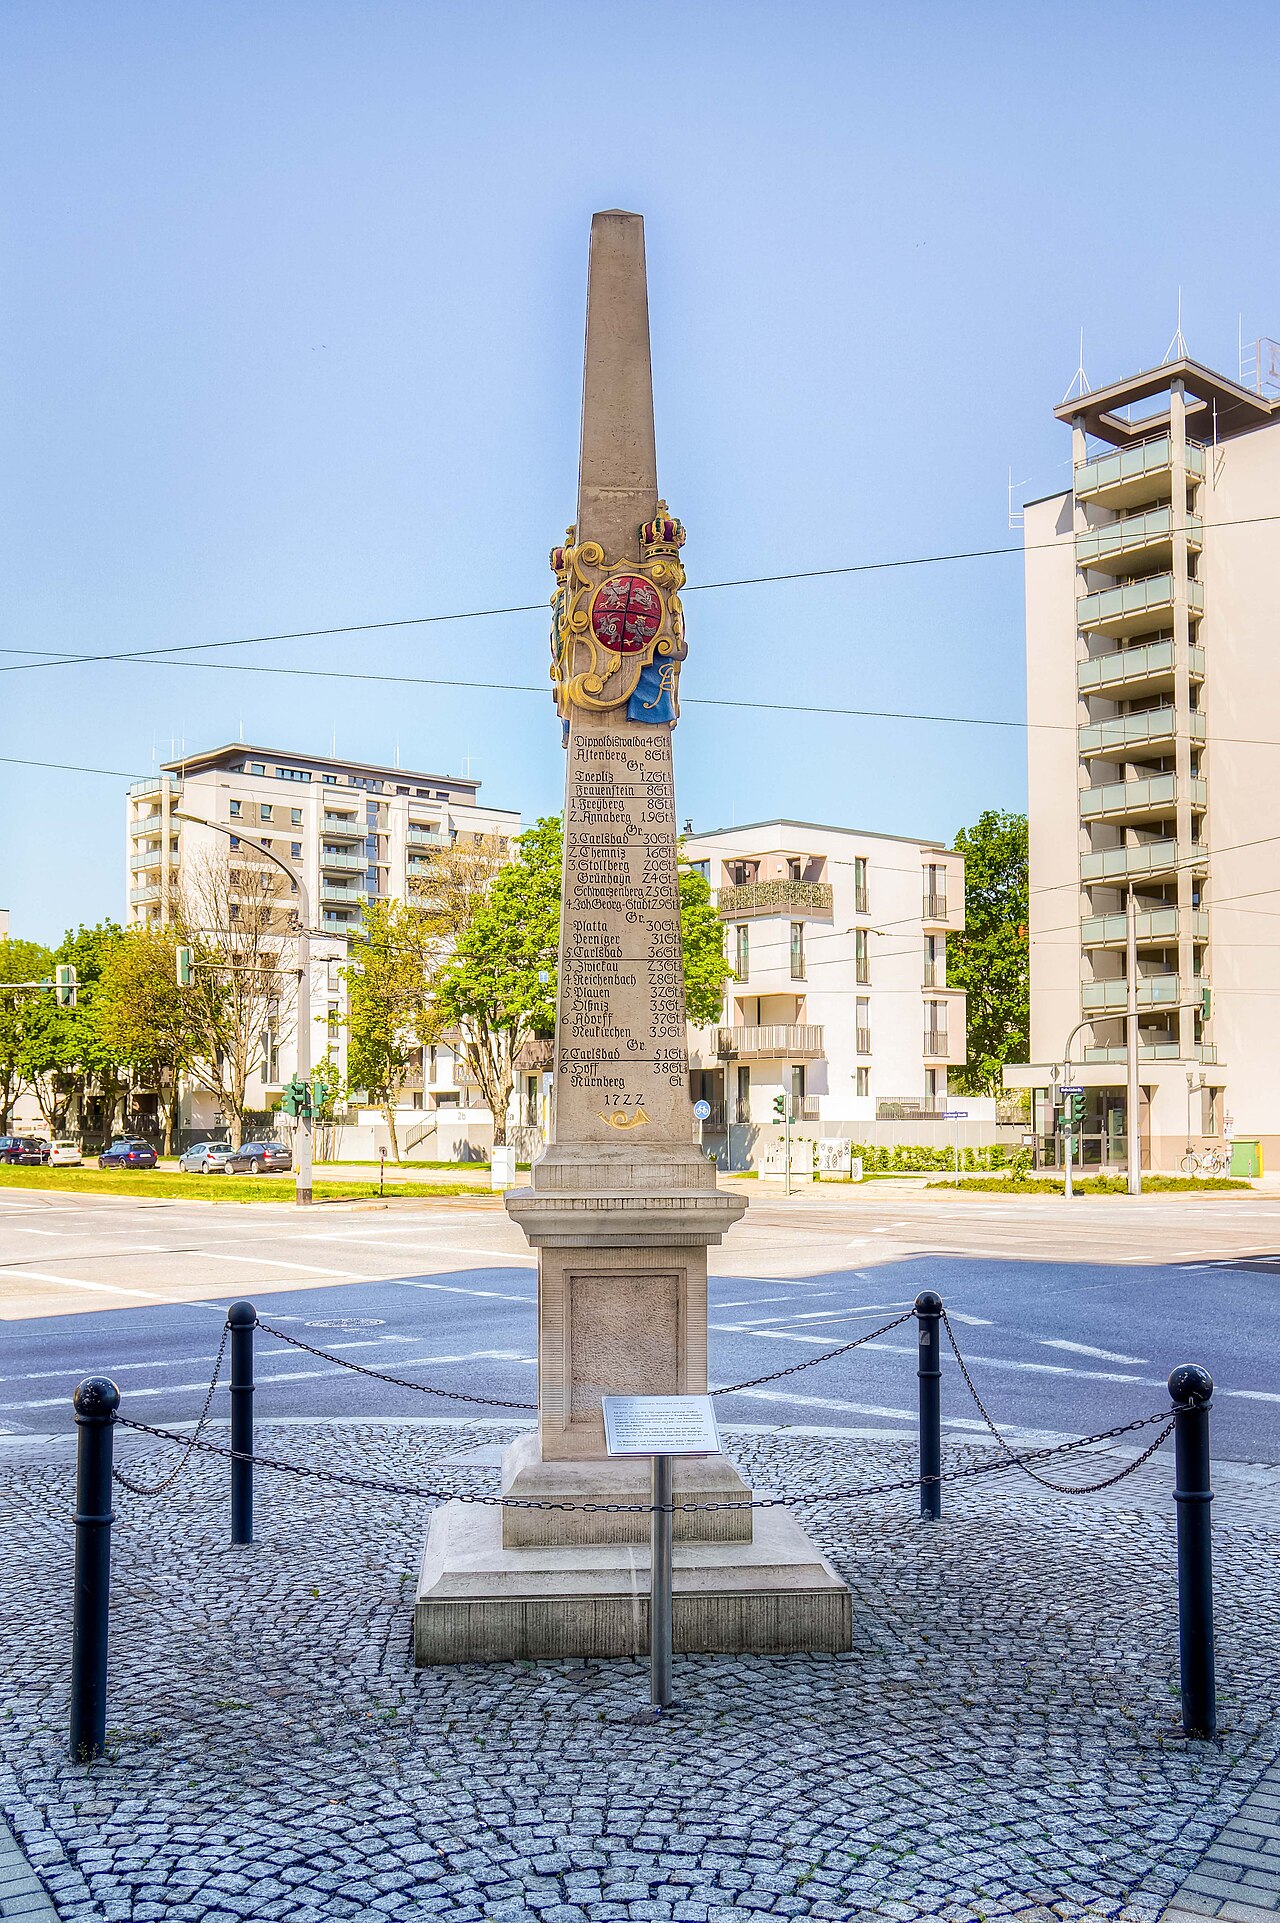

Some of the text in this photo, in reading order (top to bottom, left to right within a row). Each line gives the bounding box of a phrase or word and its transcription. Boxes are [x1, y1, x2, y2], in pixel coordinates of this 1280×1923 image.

[574, 749, 627, 762] Altenberg
[627, 760, 646, 771] Gr.
[576, 785, 634, 797] Frauenstein
[626, 824, 643, 836] Gr.
[574, 886, 644, 899] Schwarzenberg
[626, 912, 645, 923] Gr.
[573, 934, 620, 946] Perniger
[572, 1026, 631, 1039] Neukirchen
[627, 1039, 646, 1051] Gr.
[570, 1075, 684, 1089] Nürnberg St.
[605, 1094, 645, 1105] 1722
